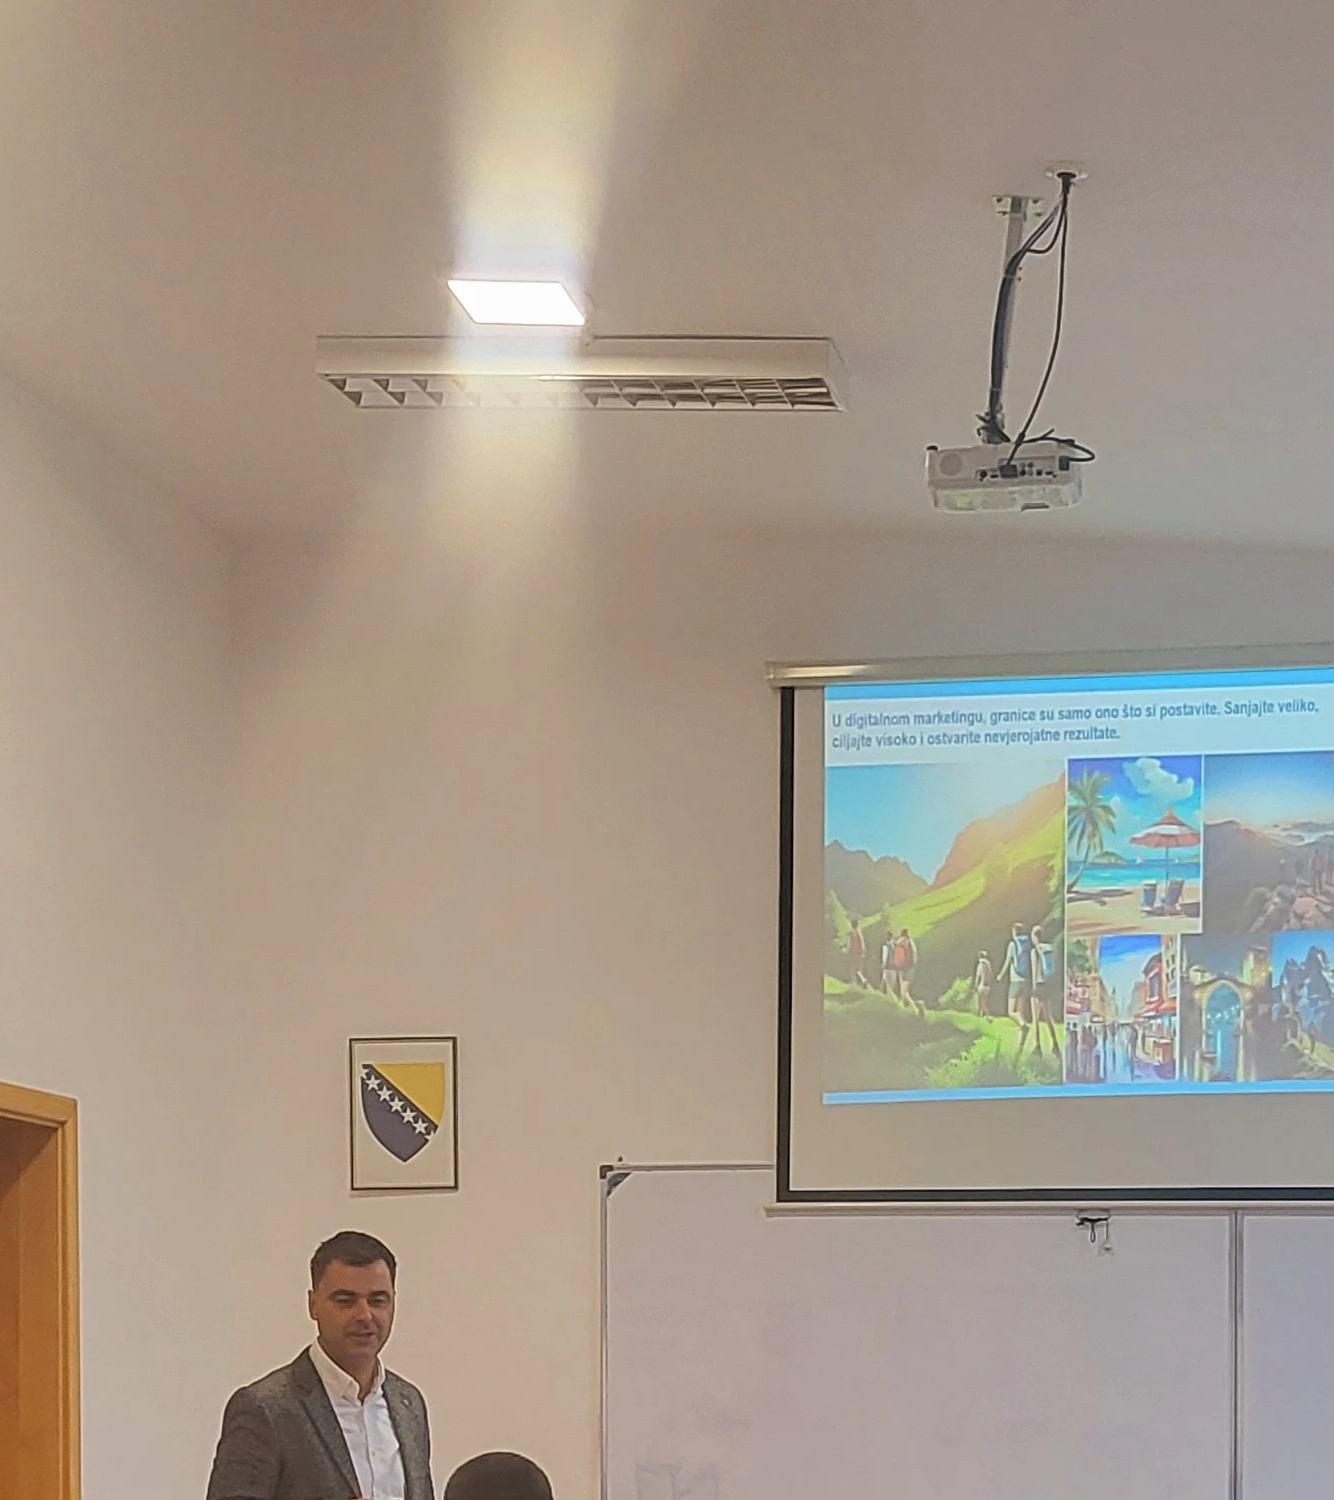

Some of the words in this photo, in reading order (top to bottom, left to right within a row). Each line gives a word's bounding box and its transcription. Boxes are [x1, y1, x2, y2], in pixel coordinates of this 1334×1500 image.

[832, 713, 841, 728] U
[845, 711, 910, 730] digitalnom
[990, 708, 1037, 726] granice
[1039, 709, 1055, 722] su
[1058, 707, 1091, 722] samo
[1095, 707, 1119, 720] ono
[1122, 703, 1142, 719] što
[1145, 703, 1157, 718] si
[1223, 700, 1274, 719] Sanjajte
[832, 731, 873, 751] ciljajte
[876, 731, 917, 747] visoko
[927, 730, 981, 746] ostvarite
[984, 728, 1061, 746] nevjerojatne
